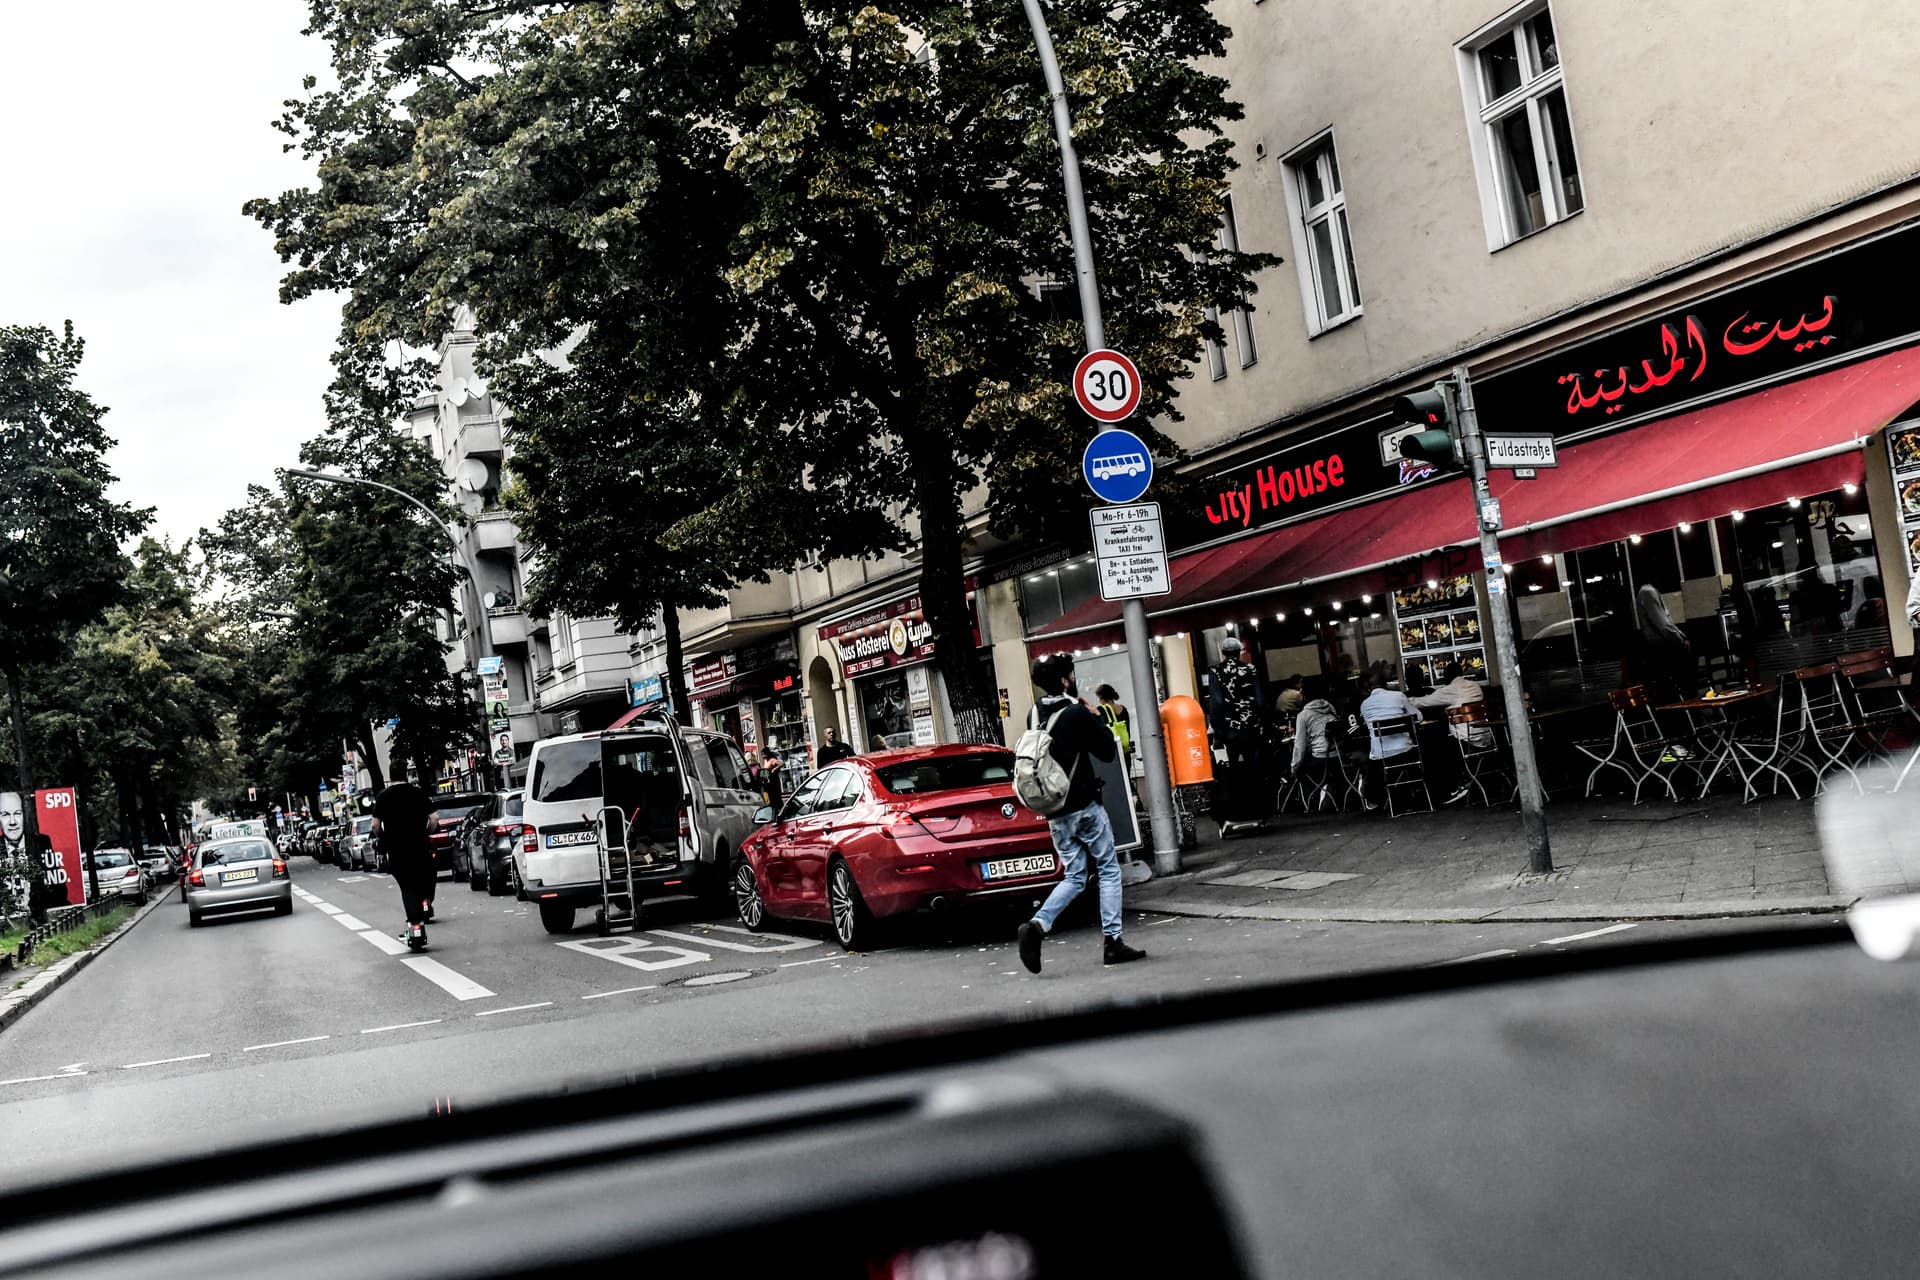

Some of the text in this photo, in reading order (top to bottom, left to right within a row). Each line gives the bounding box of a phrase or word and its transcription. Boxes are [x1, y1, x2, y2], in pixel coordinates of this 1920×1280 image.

[1557, 294, 1834, 415] بيت المدينة
[1087, 369, 1128, 401] 30
[1489, 440, 1551, 460] Fuldastraße
[1255, 452, 1345, 511] House
[1102, 508, 1149, 521] Mo-Fr 6-19h
[1104, 535, 1153, 545] Krankenfahrzeuge
[1108, 569, 1120, 577] Ein-
[1130, 566, 1159, 574] Aussteigen
[1116, 577, 1134, 586] Mo-Fr
[837, 645, 856, 663] Nuss
[856, 630, 890, 658] Rösterei
[45, 792, 71, 808] SPD
[552, 831, 596, 844] SL CX 467
[989, 856, 1053, 875] B EE 2025
